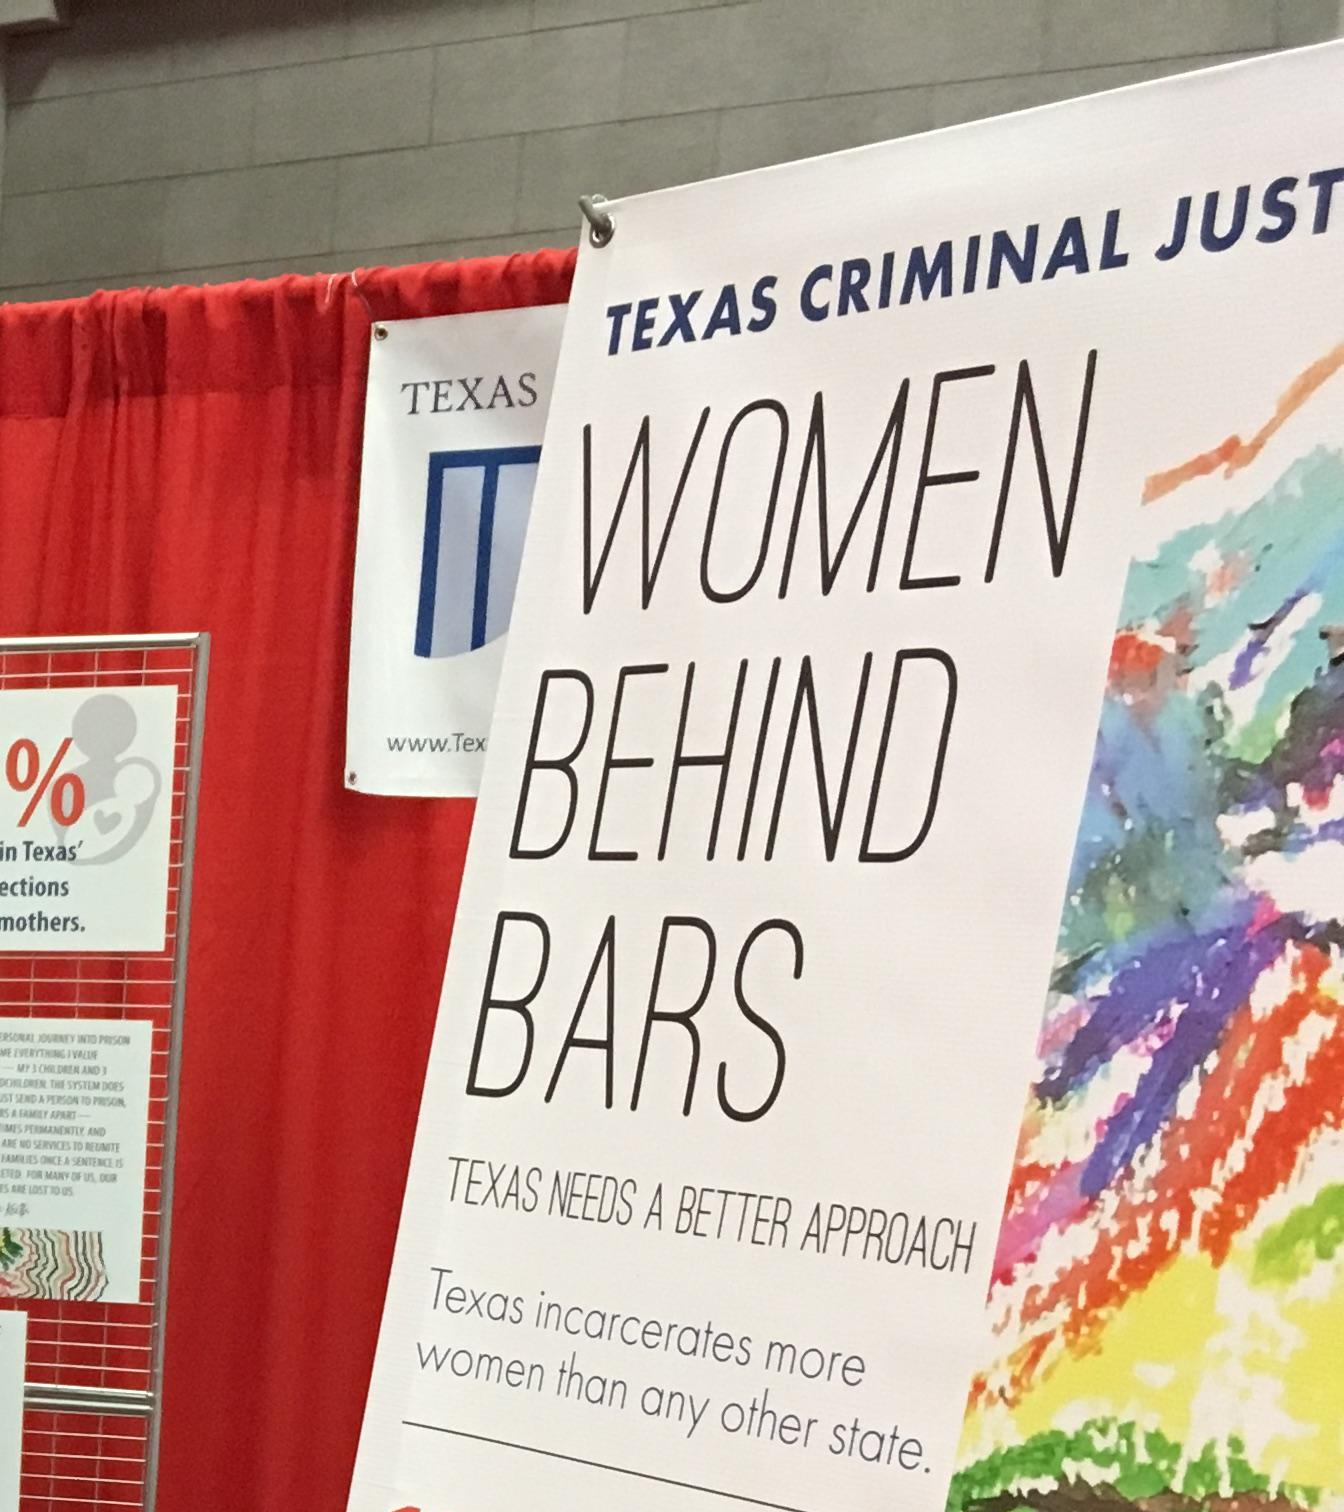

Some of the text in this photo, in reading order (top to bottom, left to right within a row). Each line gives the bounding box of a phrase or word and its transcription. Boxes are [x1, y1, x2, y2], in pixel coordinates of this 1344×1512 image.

[606, 167, 1344, 356] TEXAS CRIMINAL JUST
[401, 372, 537, 414] TEXAS
[583, 349, 1097, 615] WOMEN
[509, 648, 957, 862] BEHIND
[0, 840, 16, 861] in
[466, 911, 803, 1123] BARS
[448, 1157, 977, 1274] TEXAS NEEDS A BETTER APPROACH
[430, 1267, 865, 1386] Texas incarcerates more
[417, 1342, 930, 1473] women than any other state.
